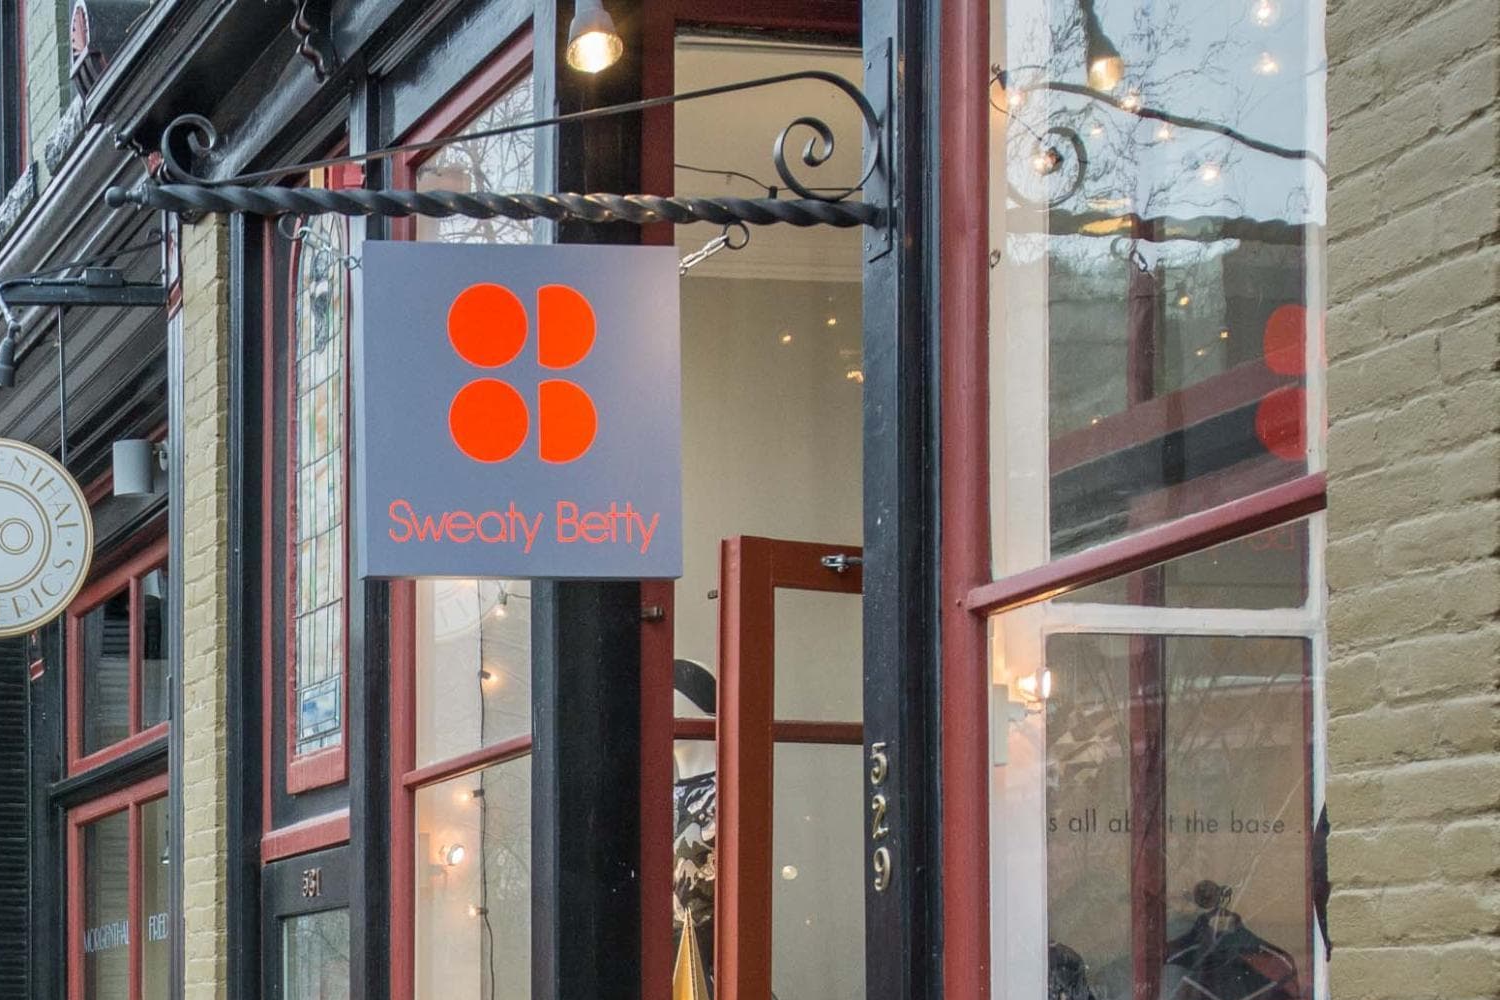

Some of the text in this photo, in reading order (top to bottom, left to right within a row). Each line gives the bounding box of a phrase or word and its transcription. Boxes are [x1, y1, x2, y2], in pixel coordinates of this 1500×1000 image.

[388, 499, 660, 555] Sweaty Betty
[870, 741, 891, 892] 529
[1068, 809, 1097, 834] all
[1185, 811, 1219, 834] the
[1231, 810, 1285, 834] base
